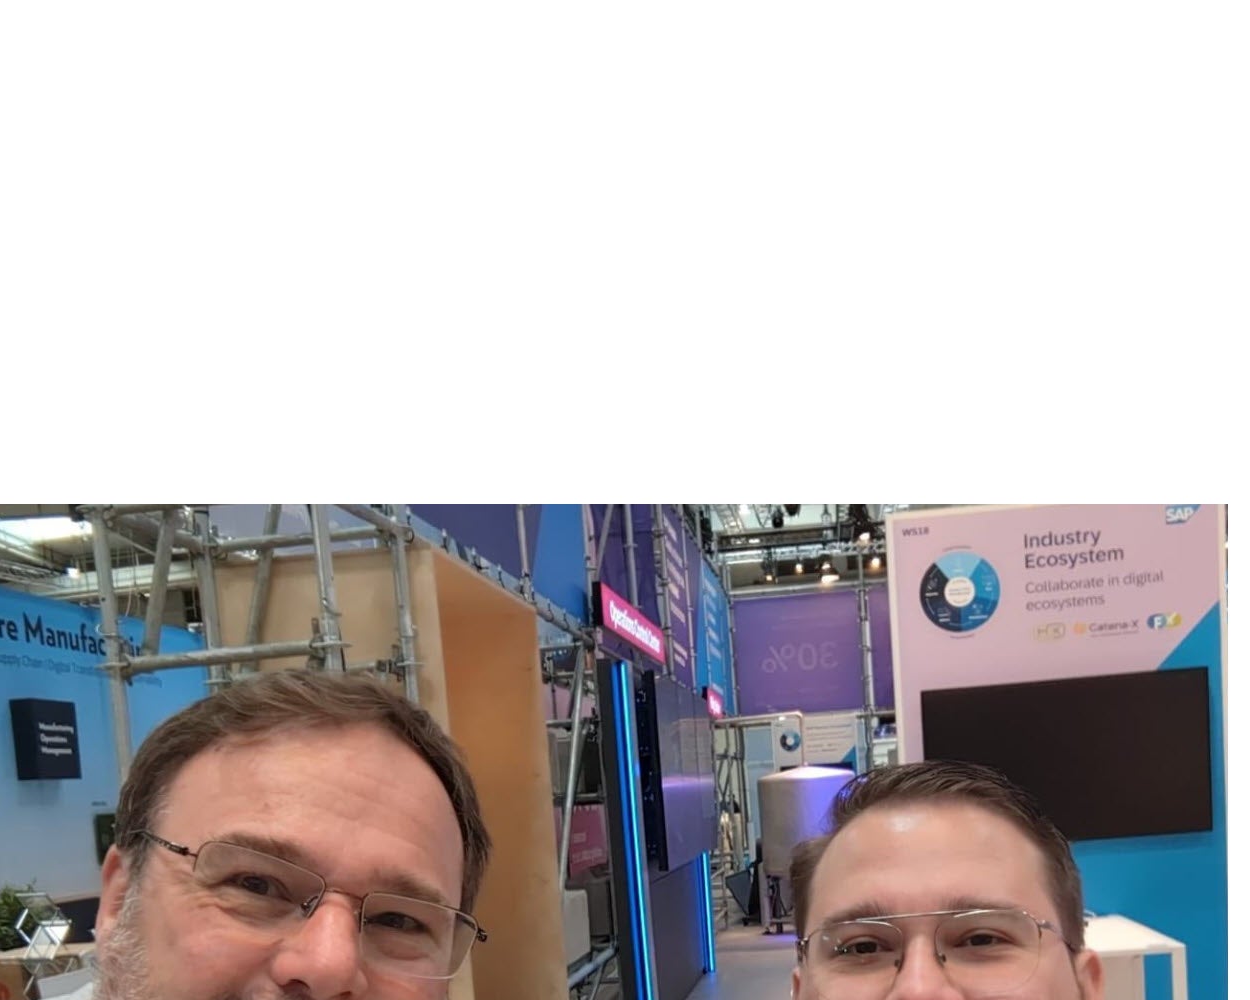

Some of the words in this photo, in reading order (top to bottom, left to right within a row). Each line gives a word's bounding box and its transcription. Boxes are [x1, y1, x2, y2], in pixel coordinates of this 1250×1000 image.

[1165, 507, 1194, 522] SAP
[902, 527, 930, 537] WS18
[1023, 530, 1101, 549] Industry
[1024, 548, 1125, 569] Ecosystem
[1025, 576, 1104, 594] Collaborate
[1108, 576, 1120, 587] in
[1123, 570, 1164, 587] digital
[1025, 595, 1106, 611] ecosystems
[1089, 619, 1139, 633] Catena-X
